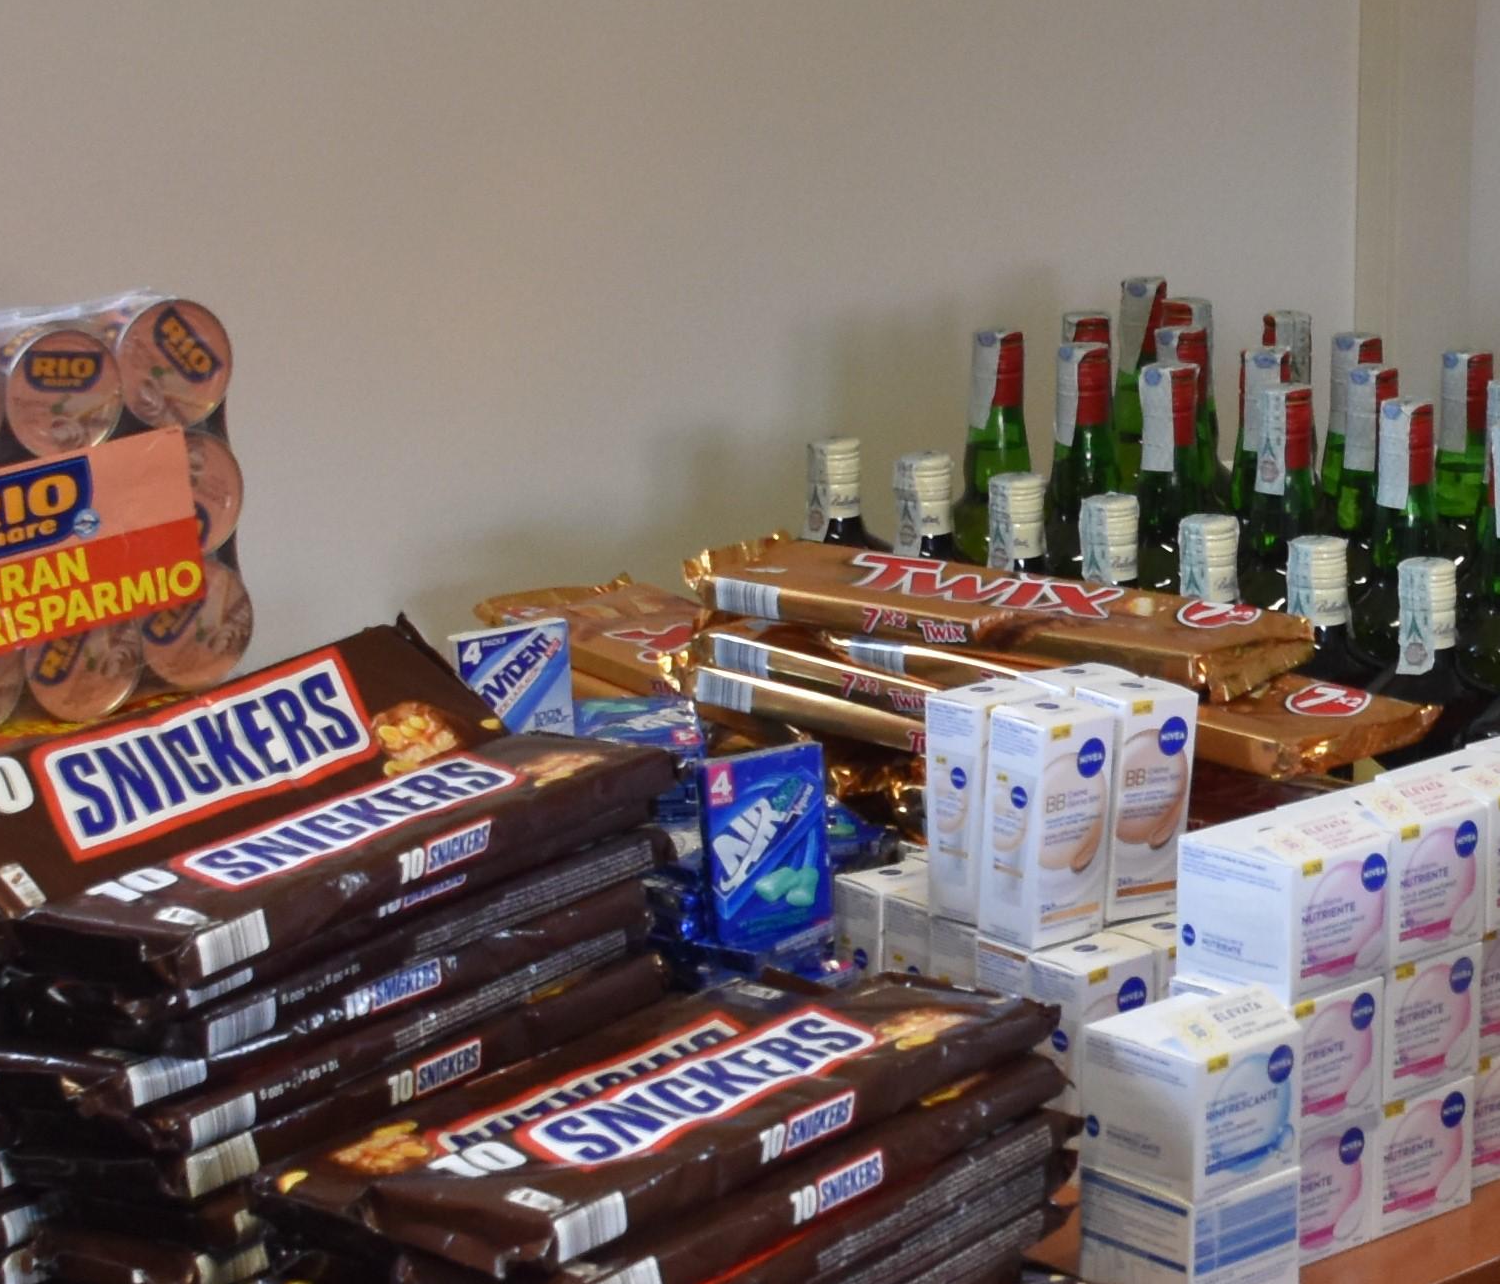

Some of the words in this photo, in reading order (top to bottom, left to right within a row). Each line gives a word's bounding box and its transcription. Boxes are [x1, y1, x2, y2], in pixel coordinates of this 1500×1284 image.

[31, 357, 97, 379] RIO
[160, 315, 214, 374] RIO
[462, 641, 482, 666] 4
[56, 671, 362, 840] SNICKERS
[710, 771, 733, 796] 4
[1124, 767, 1147, 787] BB
[88, 867, 180, 903] 10
[204, 758, 504, 880] SNICKERS
[1045, 793, 1066, 814] BB
[399, 848, 425, 885] 10
[429, 826, 490, 869] SNICKERS
[373, 960, 440, 1007] SNICKERS
[388, 1069, 414, 1106] 10
[418, 1041, 481, 1093] SNICKERS
[427, 1141, 528, 1178] 10
[544, 1015, 868, 1163] SNICKERS
[759, 1123, 786, 1164] 10
[789, 1097, 853, 1148] SNICKERS
[790, 1184, 818, 1225] 10
[819, 1156, 883, 1211] SNICKERS
